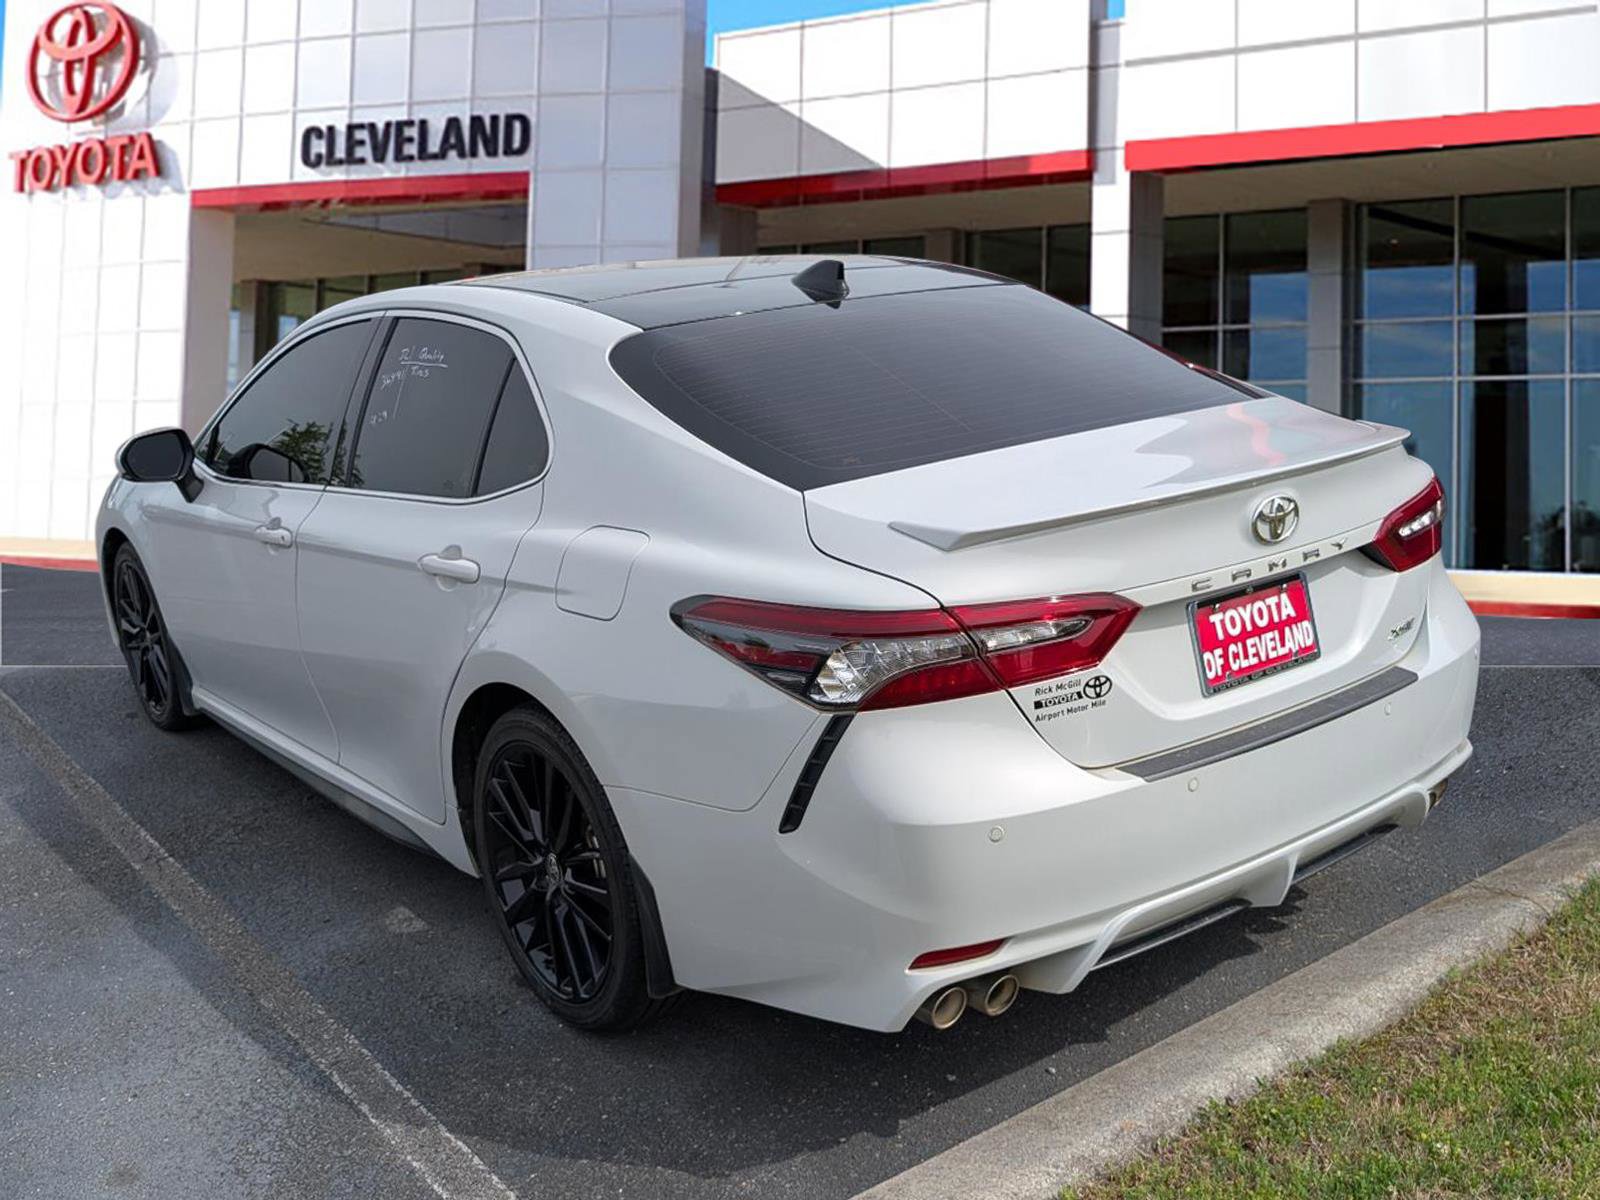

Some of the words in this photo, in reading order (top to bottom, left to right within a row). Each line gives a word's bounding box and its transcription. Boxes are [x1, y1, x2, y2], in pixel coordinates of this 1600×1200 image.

[9, 132, 161, 194] TOYOTA
[301, 113, 531, 169] CLEVELAND
[1191, 537, 1348, 592] CAMRY
[1209, 592, 1296, 641] TOYOTA
[1203, 648, 1224, 680] OF
[1229, 621, 1314, 669] CLEVELAND
[1035, 685, 1053, 696] Rick
[1056, 679, 1082, 691] McGill
[1035, 709, 1065, 722] Airport
[1066, 704, 1089, 715] Motor
[1091, 699, 1107, 709] Mile
[1042, 692, 1079, 707] TOYOTA
